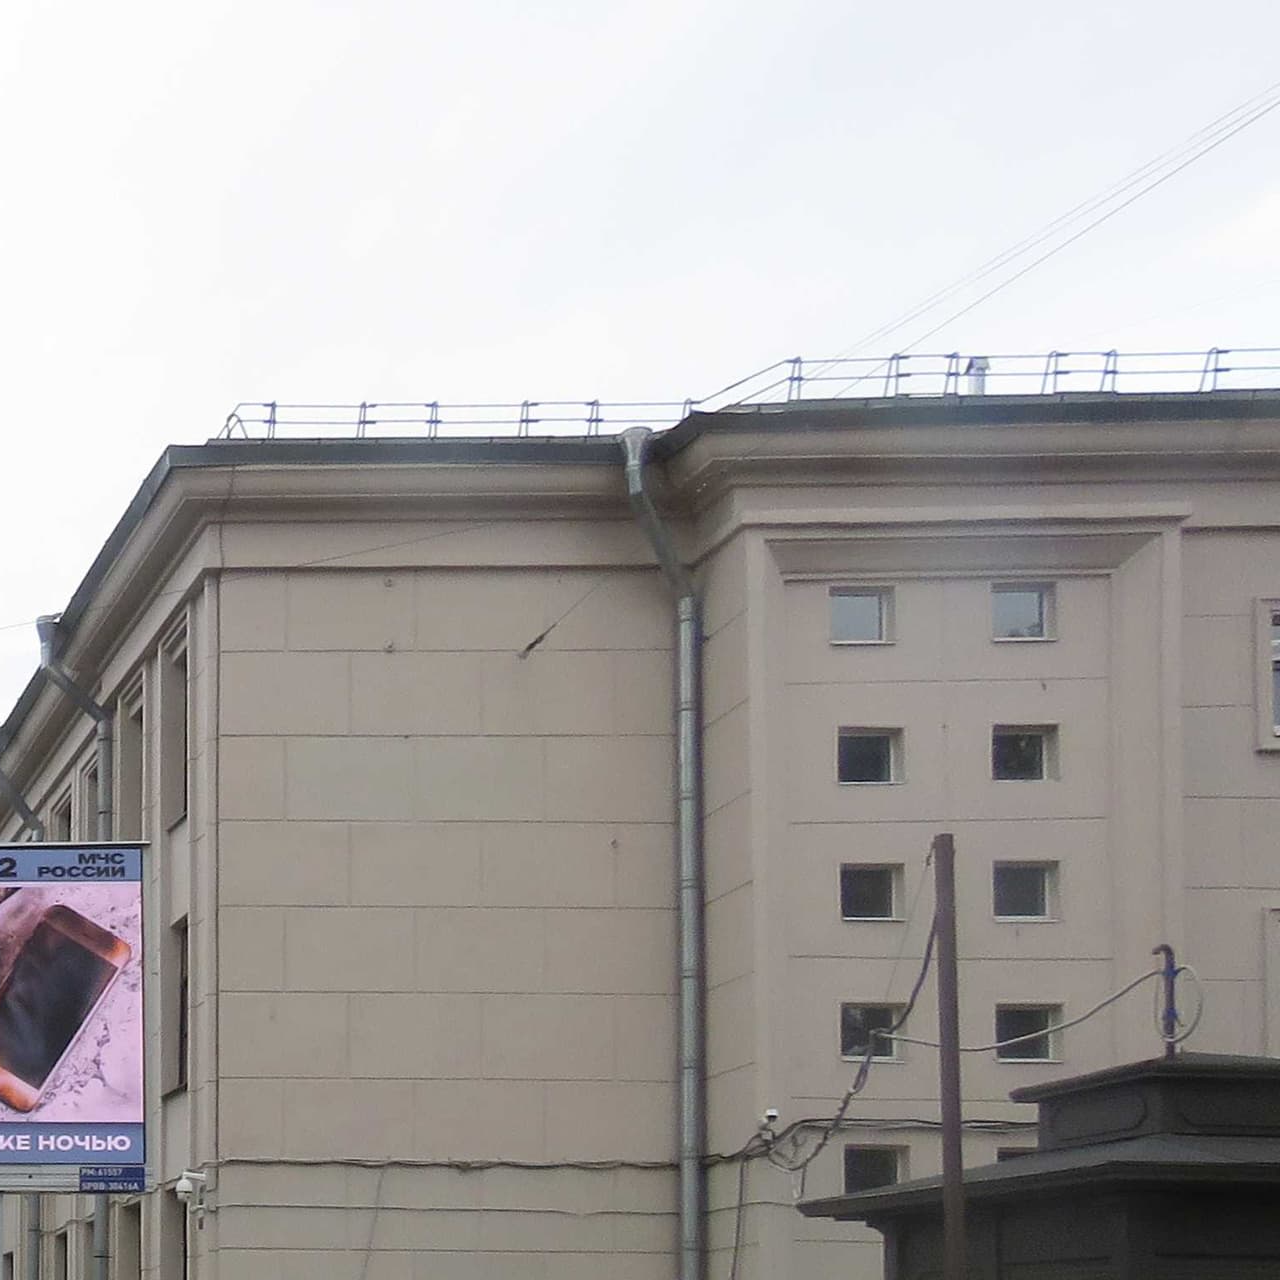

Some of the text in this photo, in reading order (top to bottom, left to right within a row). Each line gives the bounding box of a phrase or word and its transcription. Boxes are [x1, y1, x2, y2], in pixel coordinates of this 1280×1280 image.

[78, 853, 125, 865] МЧС
[37, 865, 126, 878] РОССИИ
[38, 1135, 132, 1151] НОЧЬЮ
